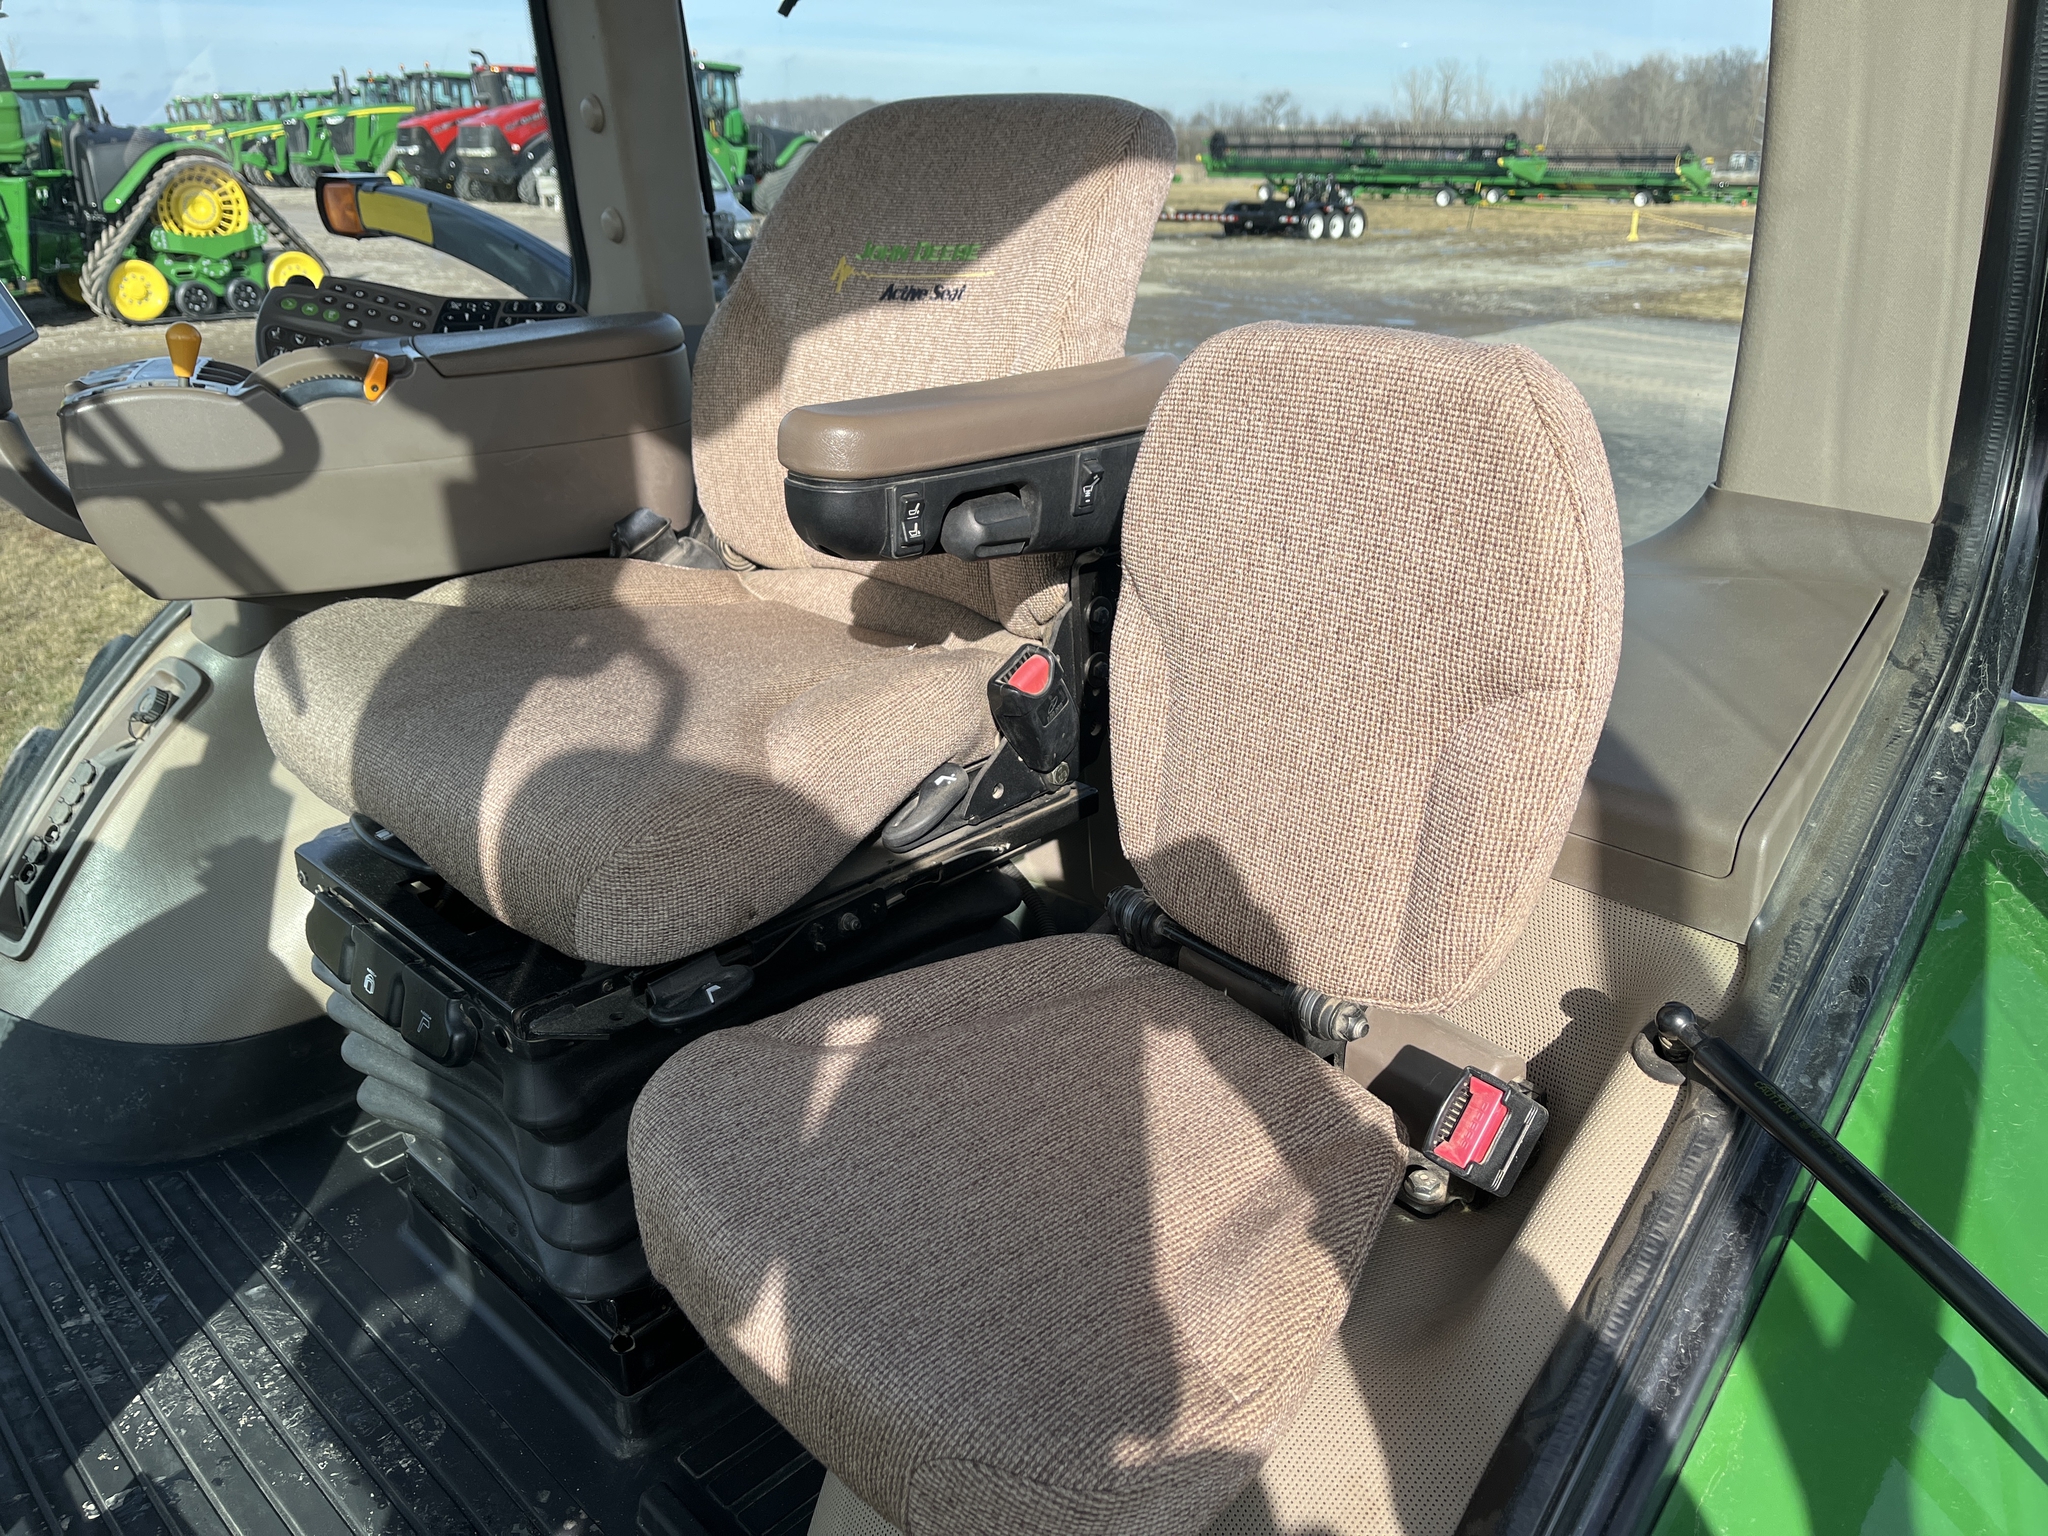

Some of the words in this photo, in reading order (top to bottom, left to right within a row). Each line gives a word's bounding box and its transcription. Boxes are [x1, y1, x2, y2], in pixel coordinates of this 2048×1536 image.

[878, 283, 928, 302] Active
[930, 284, 967, 302] Seat
[1754, 1080, 1793, 1115] CAUTION
